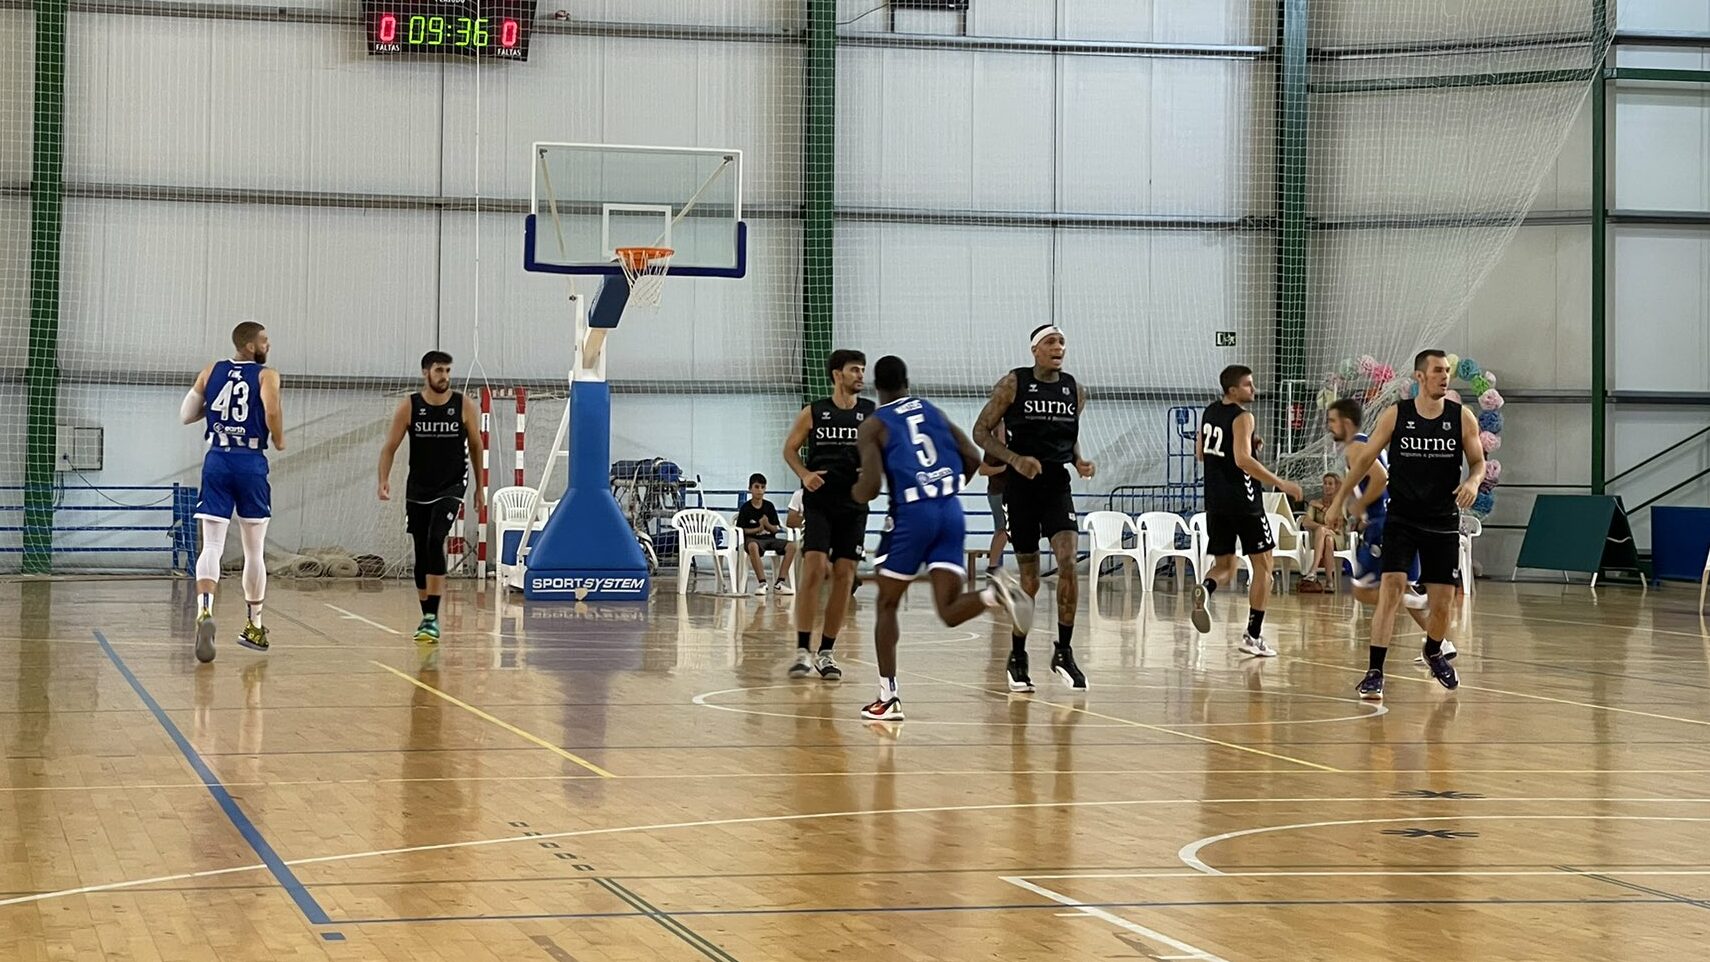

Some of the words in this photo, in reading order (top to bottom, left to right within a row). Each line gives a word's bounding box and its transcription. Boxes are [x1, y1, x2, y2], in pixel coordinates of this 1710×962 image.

[380, 16, 396, 41] 0
[409, 16, 488, 46] 09:36
[502, 21, 517, 47] 0
[497, 48, 521, 56] FALTAS
[211, 380, 249, 422] 43
[1024, 400, 1075, 415] surne
[415, 421, 459, 432] surne
[816, 426, 859, 439] surn
[906, 413, 938, 467] 5
[1203, 423, 1225, 457] 22
[1400, 436, 1456, 451] surne
